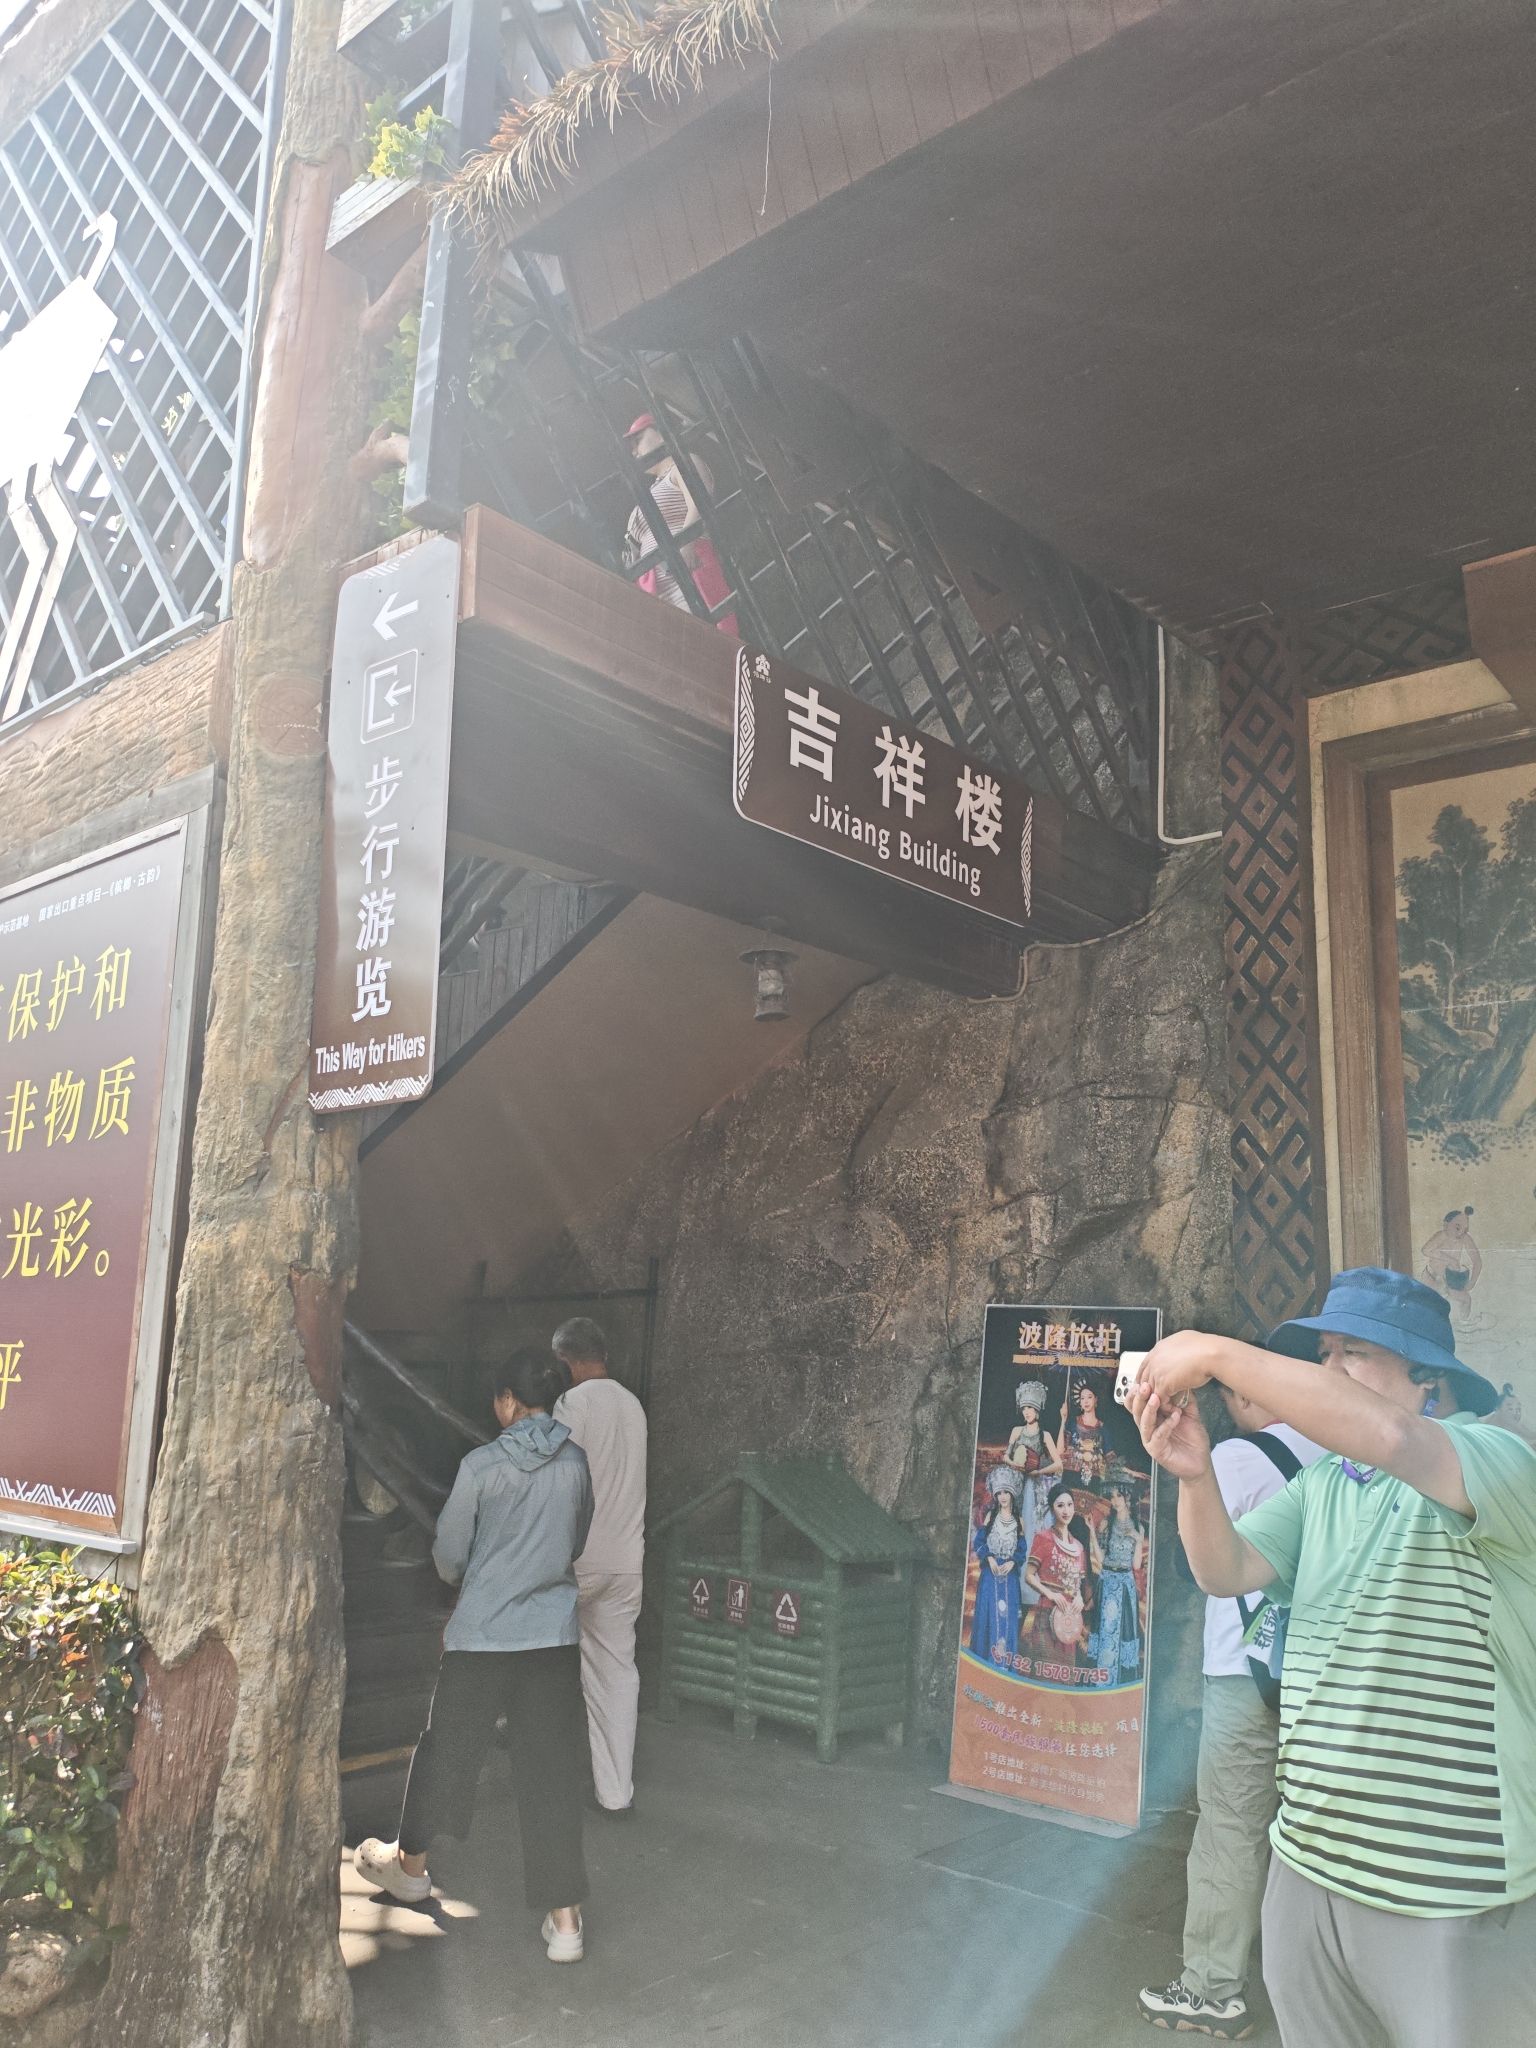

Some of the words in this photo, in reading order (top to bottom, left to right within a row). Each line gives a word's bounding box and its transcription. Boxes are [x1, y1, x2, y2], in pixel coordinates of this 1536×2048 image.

[784, 686, 1002, 857] 吉祥楼
[351, 756, 403, 1022] 步行游览
[809, 794, 890, 859] Jixiang
[900, 830, 982, 897] Building
[0, 944, 132, 1043] 保护和
[315, 1046, 340, 1075] This
[342, 1041, 366, 1075] Way
[368, 1036, 387, 1066] for
[387, 1032, 426, 1063] Hikers
[0, 1056, 136, 1153] 非物质
[1018, 1321, 1122, 1354] 波隆旅拍
[1005, 1650, 1031, 1672] 132
[1035, 1662, 1071, 1681] 1578
[1073, 1666, 1109, 1684] 7735
